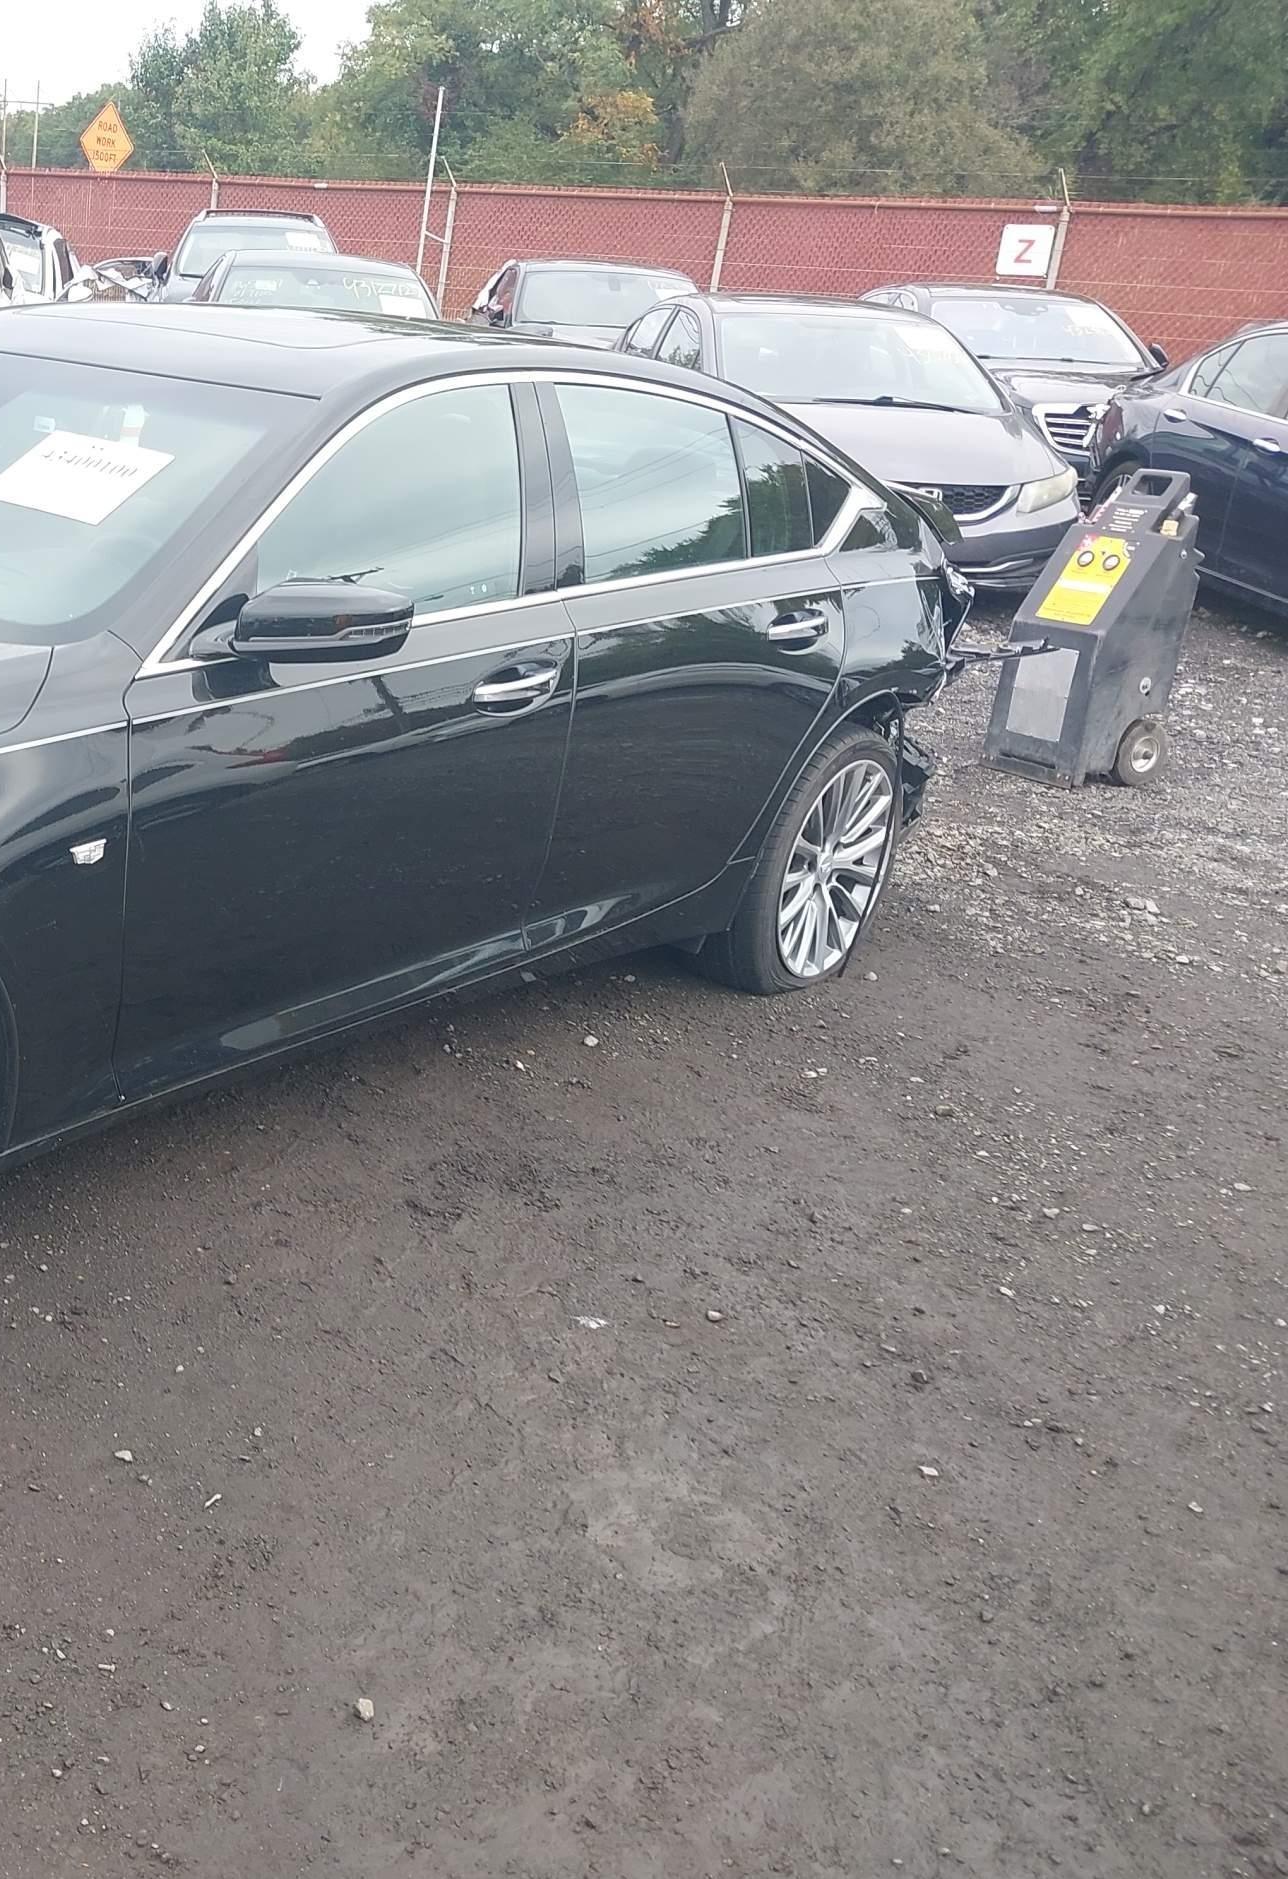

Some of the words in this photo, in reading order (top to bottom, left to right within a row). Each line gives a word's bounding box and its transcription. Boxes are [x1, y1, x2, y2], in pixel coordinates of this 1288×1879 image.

[98, 120, 118, 133] ROAD
[96, 136, 116, 148] WORK
[1013, 239, 1036, 264] Z
